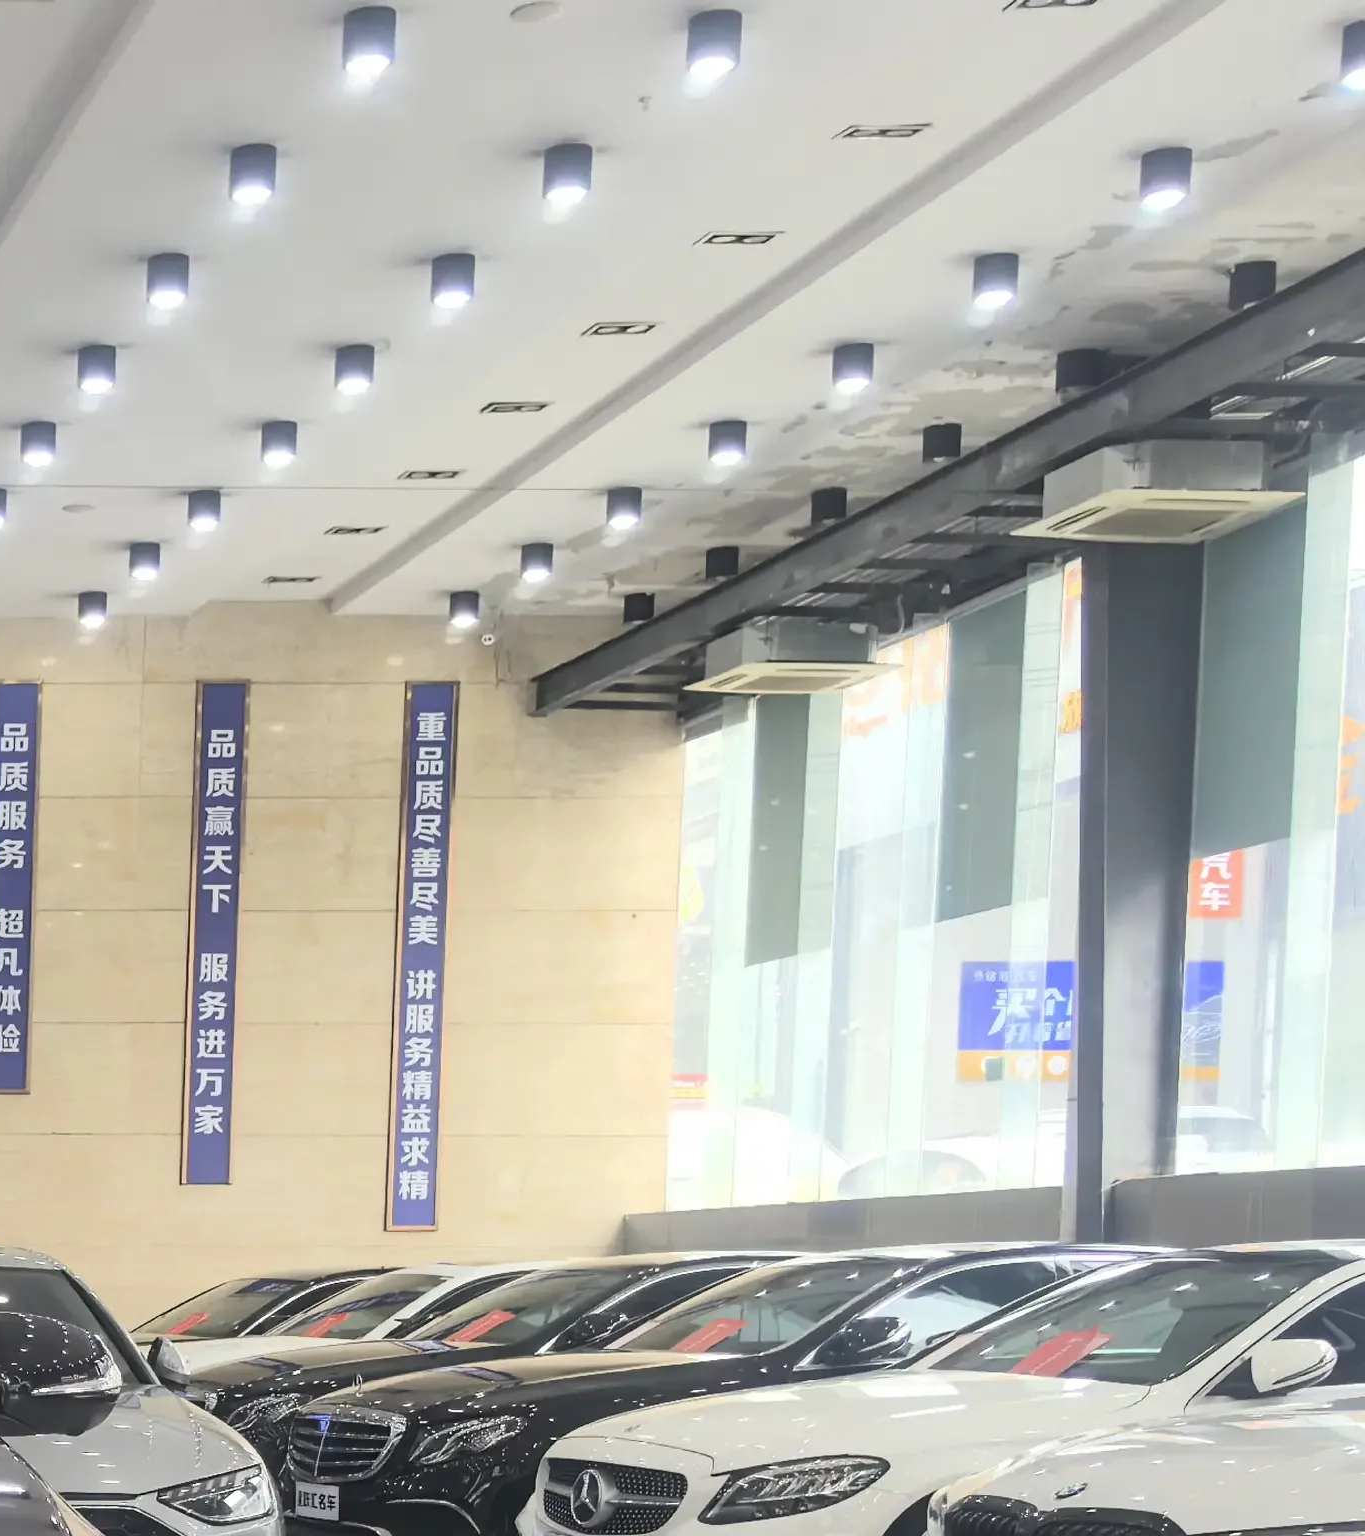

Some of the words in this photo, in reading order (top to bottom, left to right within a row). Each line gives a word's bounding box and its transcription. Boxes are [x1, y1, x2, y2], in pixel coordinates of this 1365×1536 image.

[201, 728, 236, 914] 品质赢天下
[406, 711, 447, 946] 重品质尽善尽美
[193, 952, 229, 1135] 服务进万家
[397, 970, 439, 1201] 讲服务精益求精
